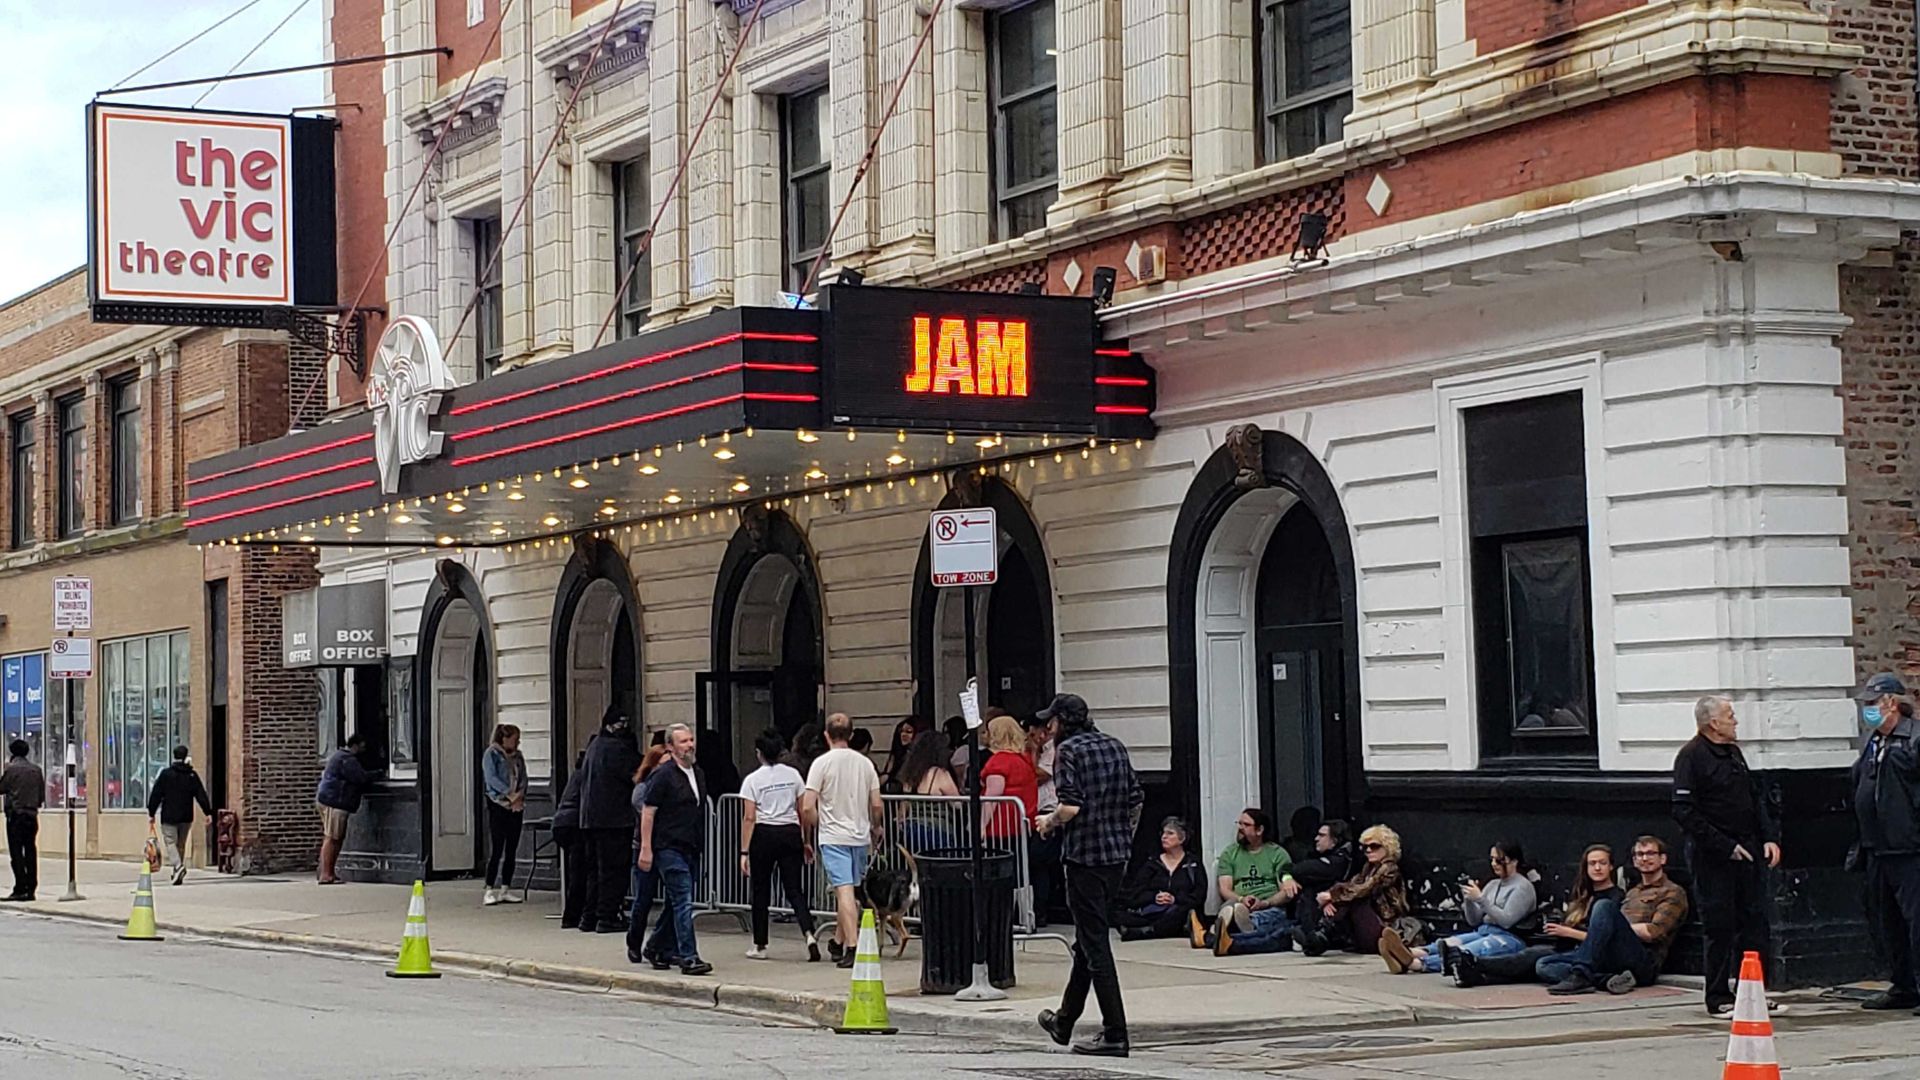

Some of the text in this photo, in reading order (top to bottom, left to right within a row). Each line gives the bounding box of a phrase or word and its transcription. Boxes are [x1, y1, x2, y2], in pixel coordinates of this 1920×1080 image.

[176, 138, 278, 191] the
[179, 191, 273, 243] vic
[119, 241, 274, 284] theatre
[905, 314, 1029, 398] JAM
[936, 571, 990, 584] TOW ZONE
[293, 632, 307, 645] BOX
[337, 629, 375, 642] BOX
[289, 648, 312, 663] OFFICE
[322, 646, 388, 660] OFFICE
